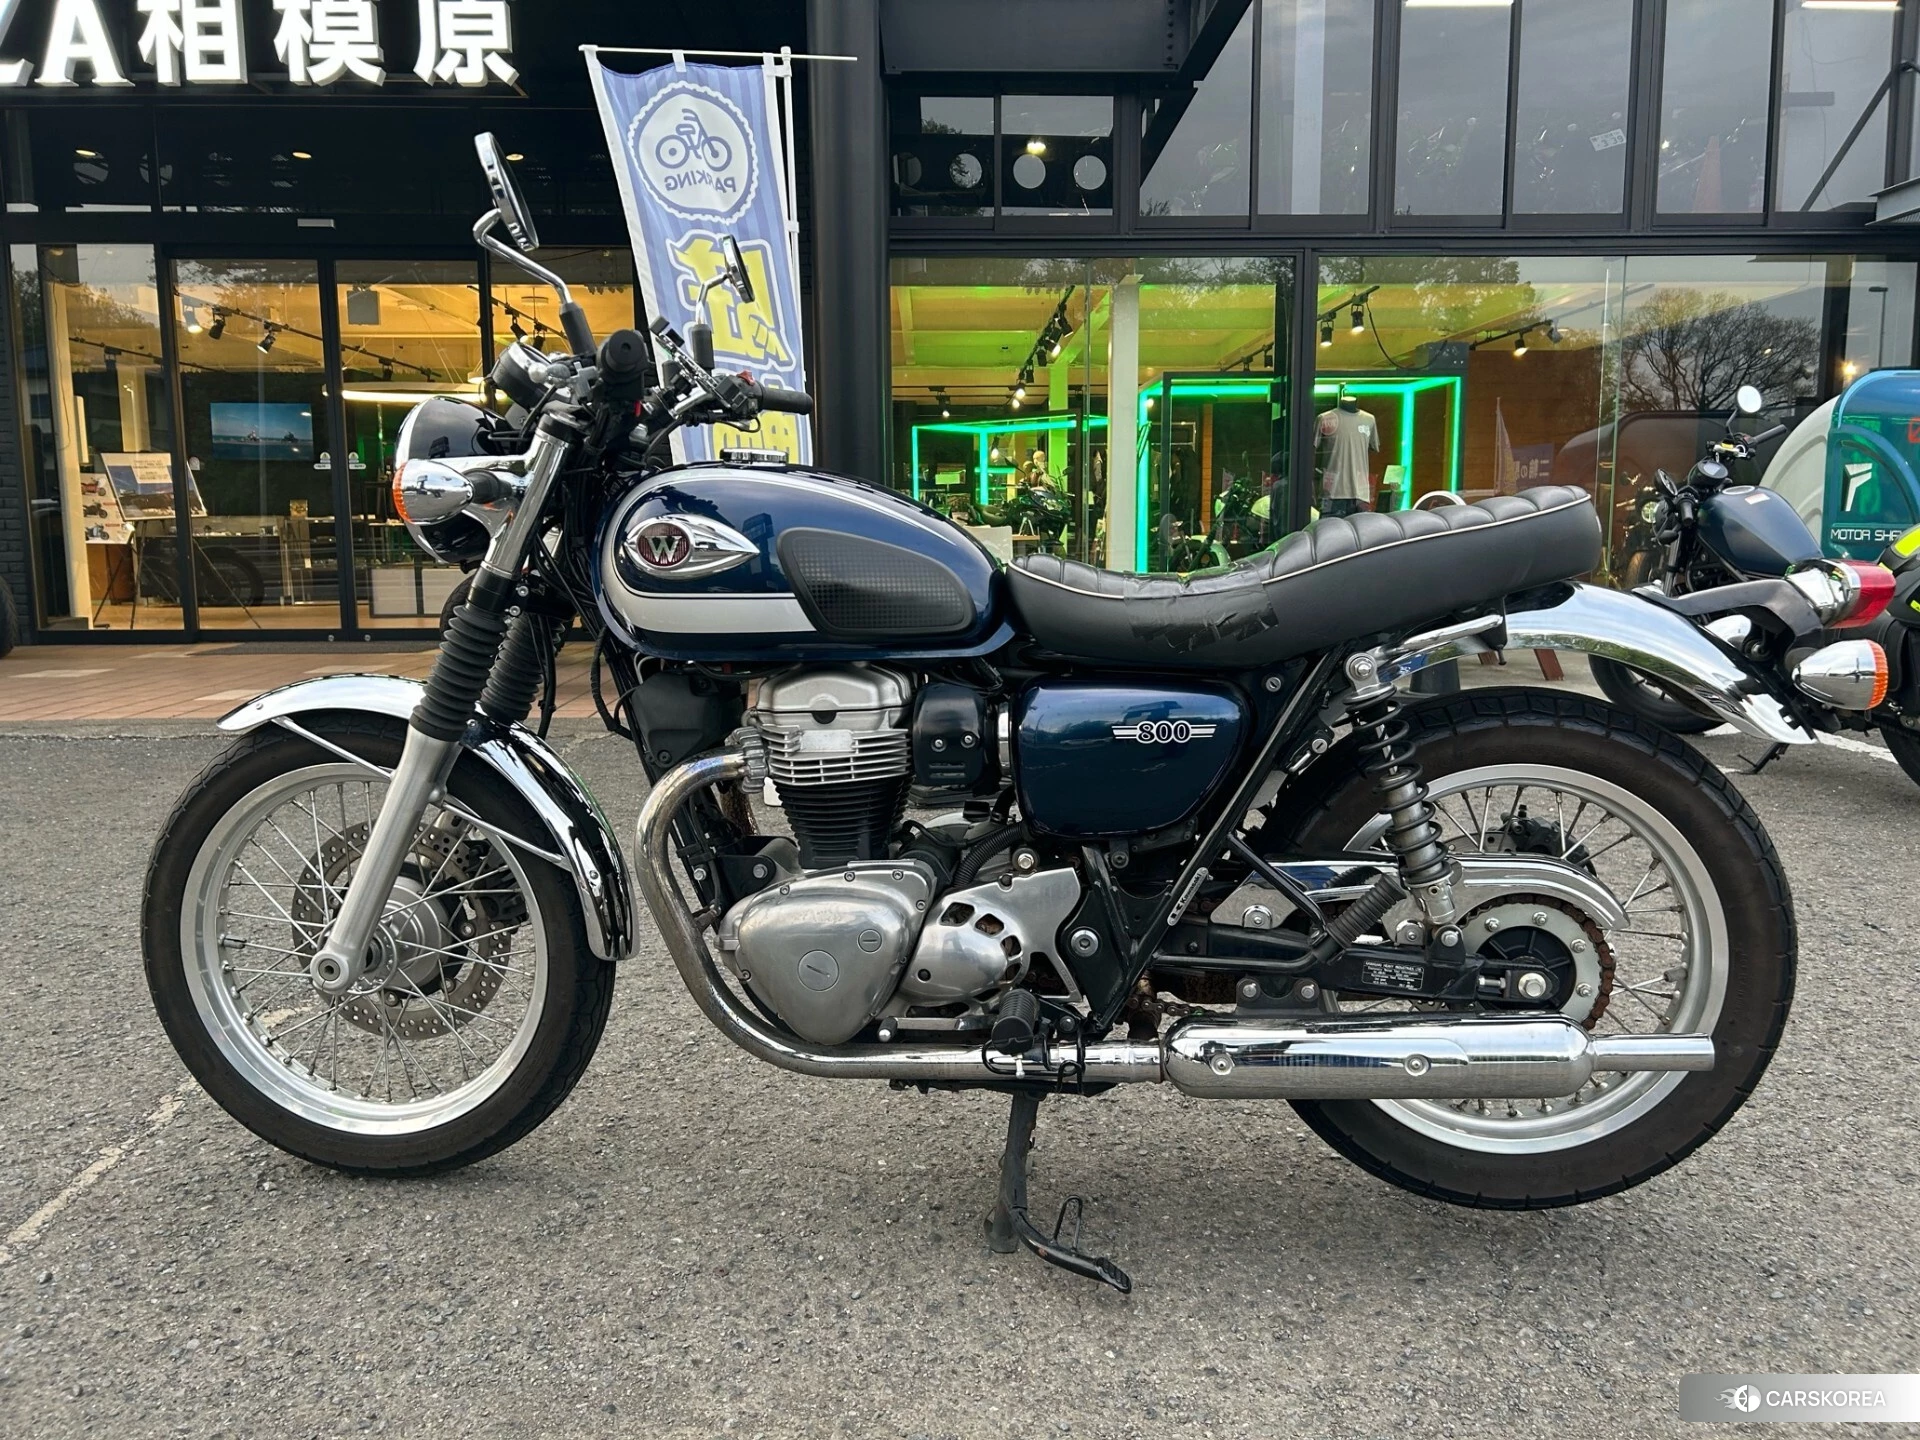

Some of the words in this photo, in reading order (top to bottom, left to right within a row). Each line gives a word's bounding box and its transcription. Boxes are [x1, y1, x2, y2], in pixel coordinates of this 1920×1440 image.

[1830, 528, 1870, 541] MOTOR
[645, 534, 683, 564] W
[1136, 720, 1191, 744] 800
